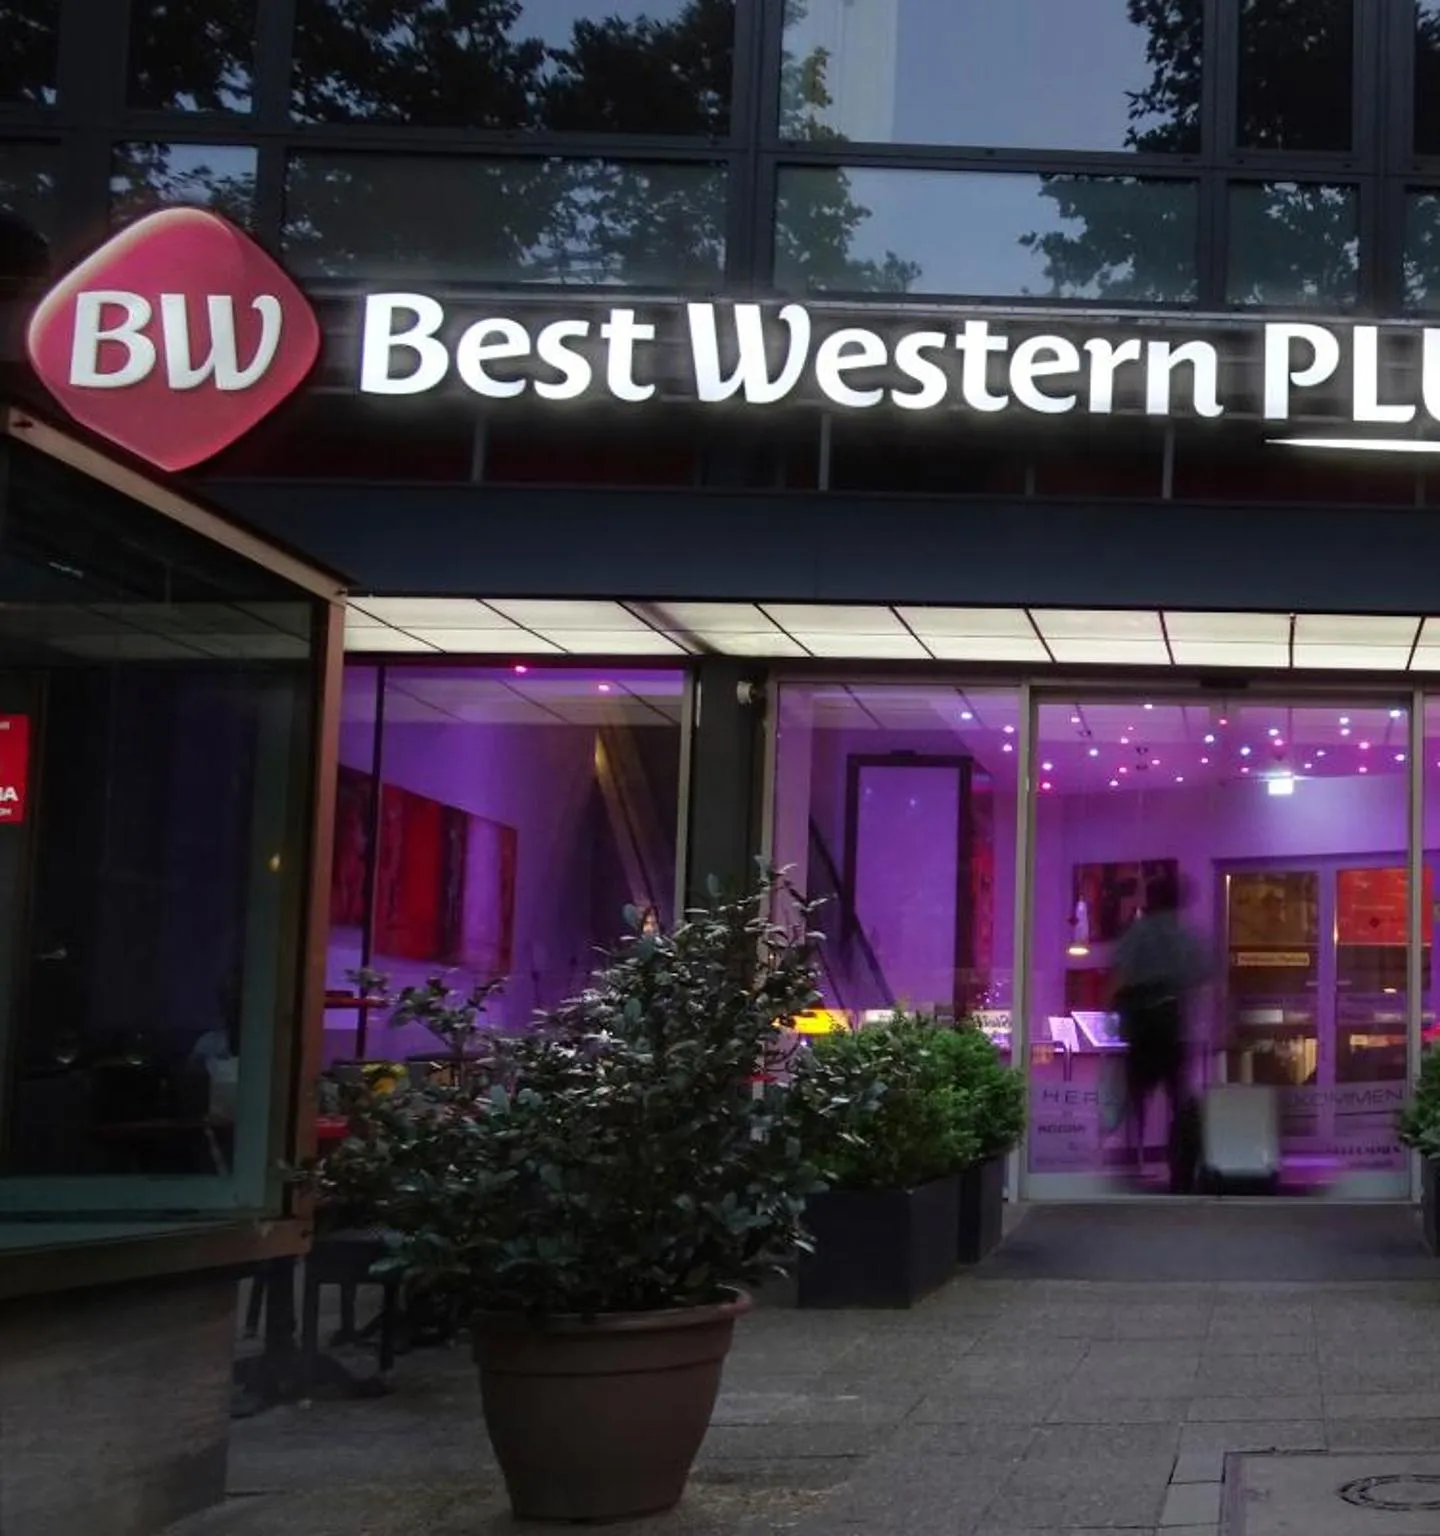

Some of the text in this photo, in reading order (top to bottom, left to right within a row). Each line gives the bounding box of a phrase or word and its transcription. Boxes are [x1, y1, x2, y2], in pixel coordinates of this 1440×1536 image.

[70, 290, 282, 392] BW
[360, 292, 655, 402] Best
[687, 302, 1224, 418] Western
